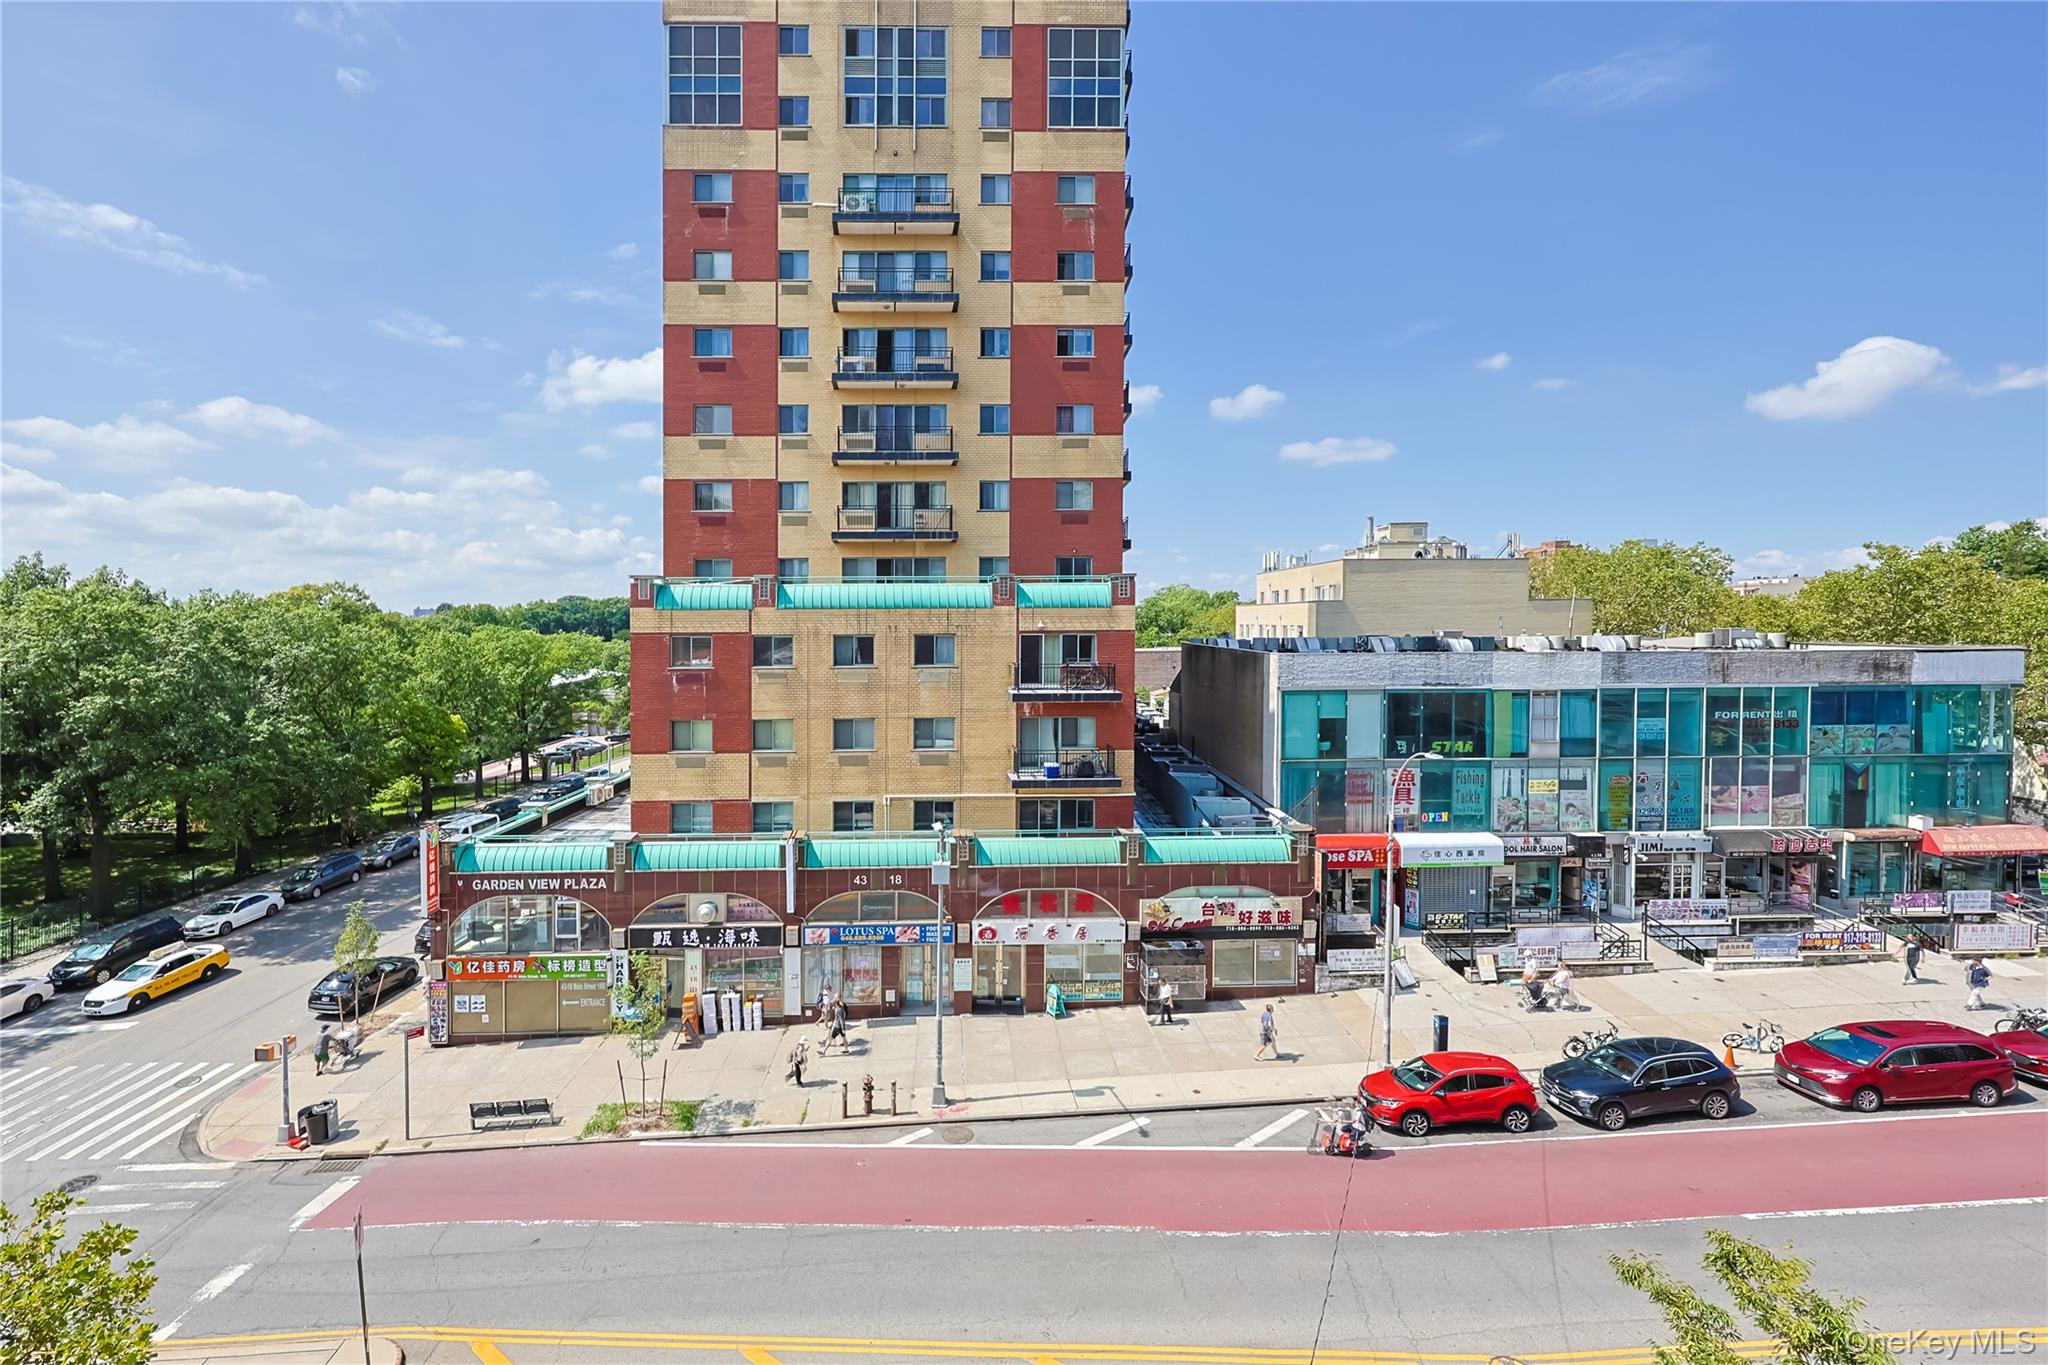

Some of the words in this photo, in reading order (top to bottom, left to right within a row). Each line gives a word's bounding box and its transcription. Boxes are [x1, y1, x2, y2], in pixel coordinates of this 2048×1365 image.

[1714, 711, 1739, 719] FOR
[1743, 711, 1772, 719] RENT
[1455, 770, 1485, 790] Fishing
[1456, 789, 1481, 804] Tackle
[1421, 812, 1449, 822] OPEN
[1503, 845, 1518, 853] DOL
[1520, 845, 1538, 853] HAIR
[1638, 842, 1663, 852] JIMI
[1327, 853, 1345, 862] ose
[1347, 849, 1374, 862] SPA
[472, 879, 524, 891] GARDEN
[528, 878, 560, 890] VIEW
[564, 877, 607, 889] PLAZA
[853, 875, 868, 885] 43
[889, 874, 902, 885] 18
[1238, 910, 1292, 925] 好滋味
[839, 927, 874, 936] LOTUS
[876, 926, 895, 936] SPA
[1015, 926, 1088, 940] 酒香居
[467, 960, 525, 973] 亿佳药房
[548, 959, 607, 973] 标榜造型
[580, 998, 606, 1007] ENTRANCE
